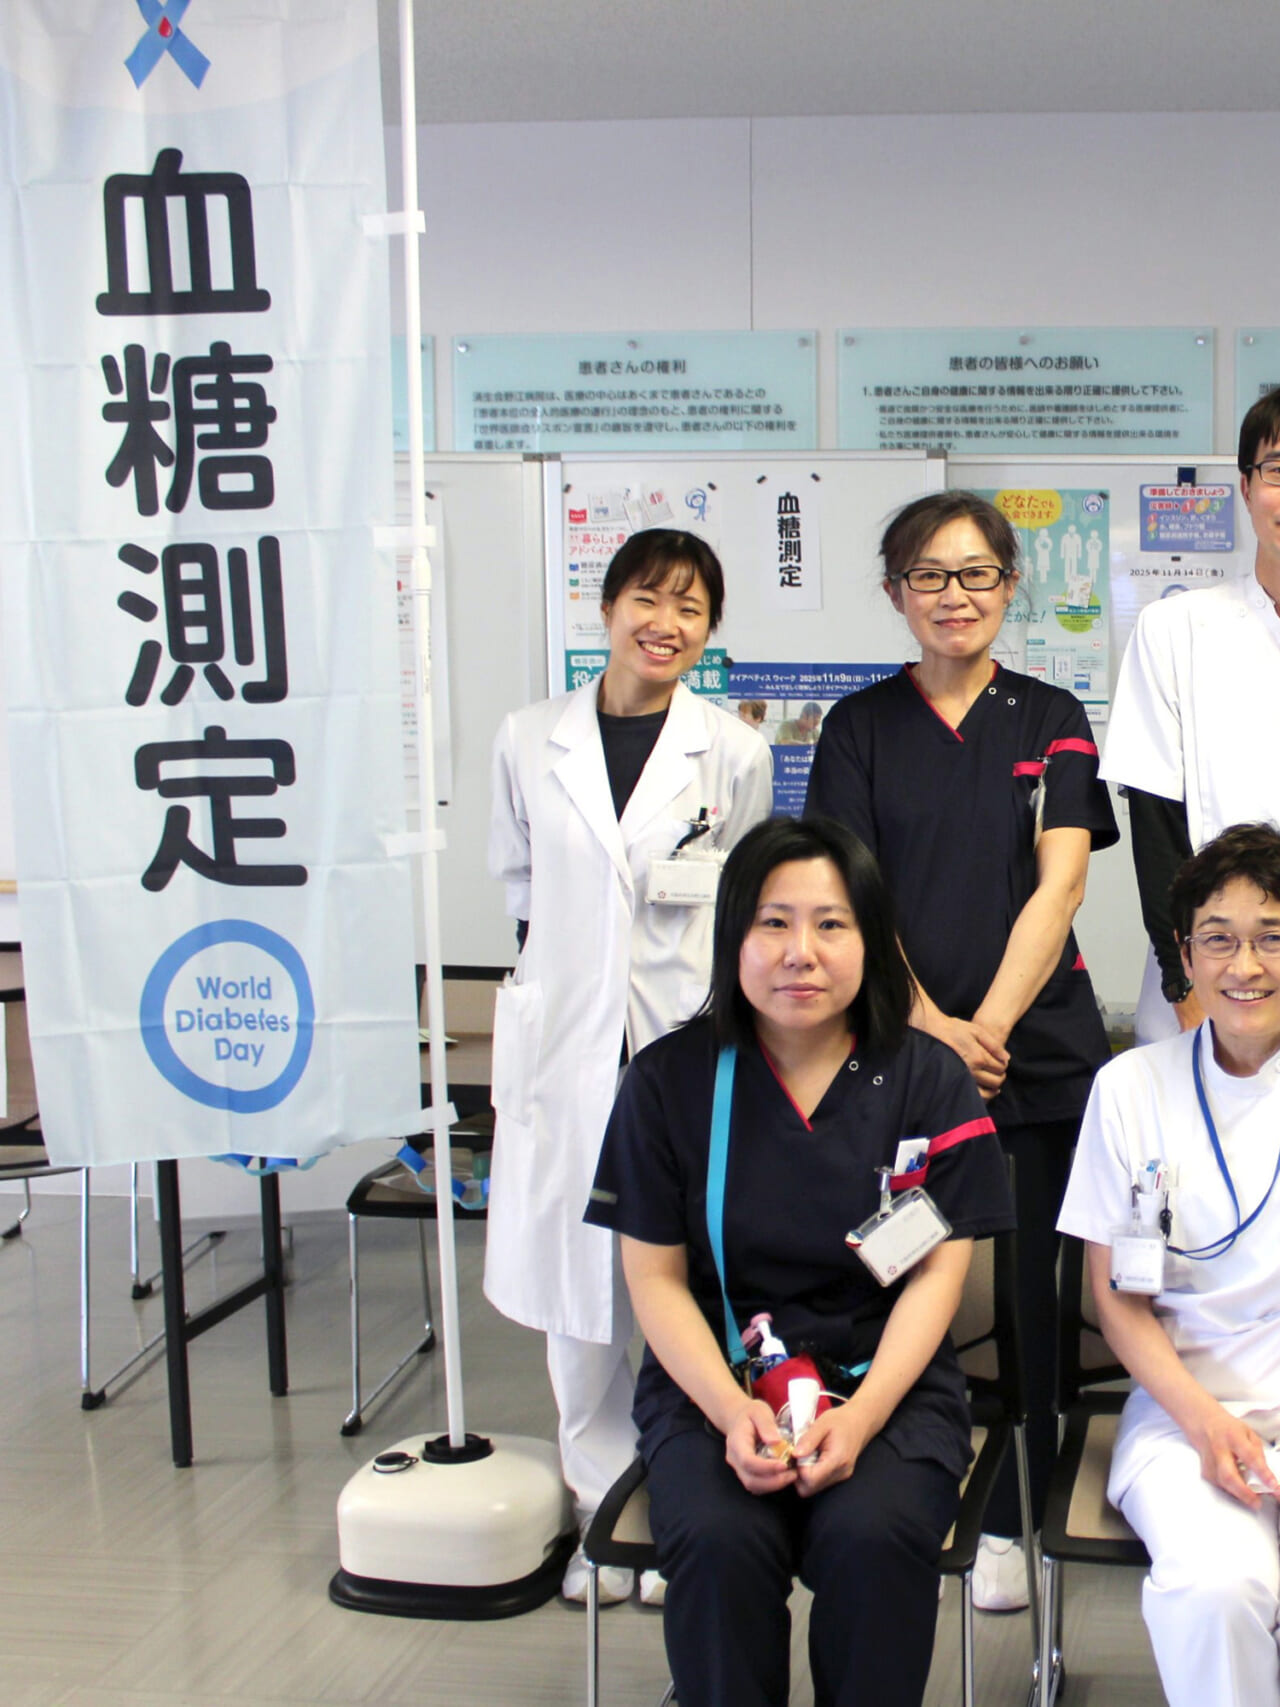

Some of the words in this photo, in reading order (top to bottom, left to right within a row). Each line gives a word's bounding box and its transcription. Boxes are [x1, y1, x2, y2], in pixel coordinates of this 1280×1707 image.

[578, 358, 687, 376] 患者さんの権利
[949, 355, 1099, 372] 患者の皆様へのお願い
[1002, 494, 1055, 509] どなたでも
[97, 149, 307, 891] 血糖測定
[777, 491, 802, 588] 血糖測定
[680, 670, 722, 689] 満載
[729, 673, 771, 682] ダイアベティス
[774, 674, 796, 682] ウィーク
[196, 975, 272, 1001] World
[175, 1007, 291, 1034] Diabetes
[214, 1037, 266, 1067] Day
